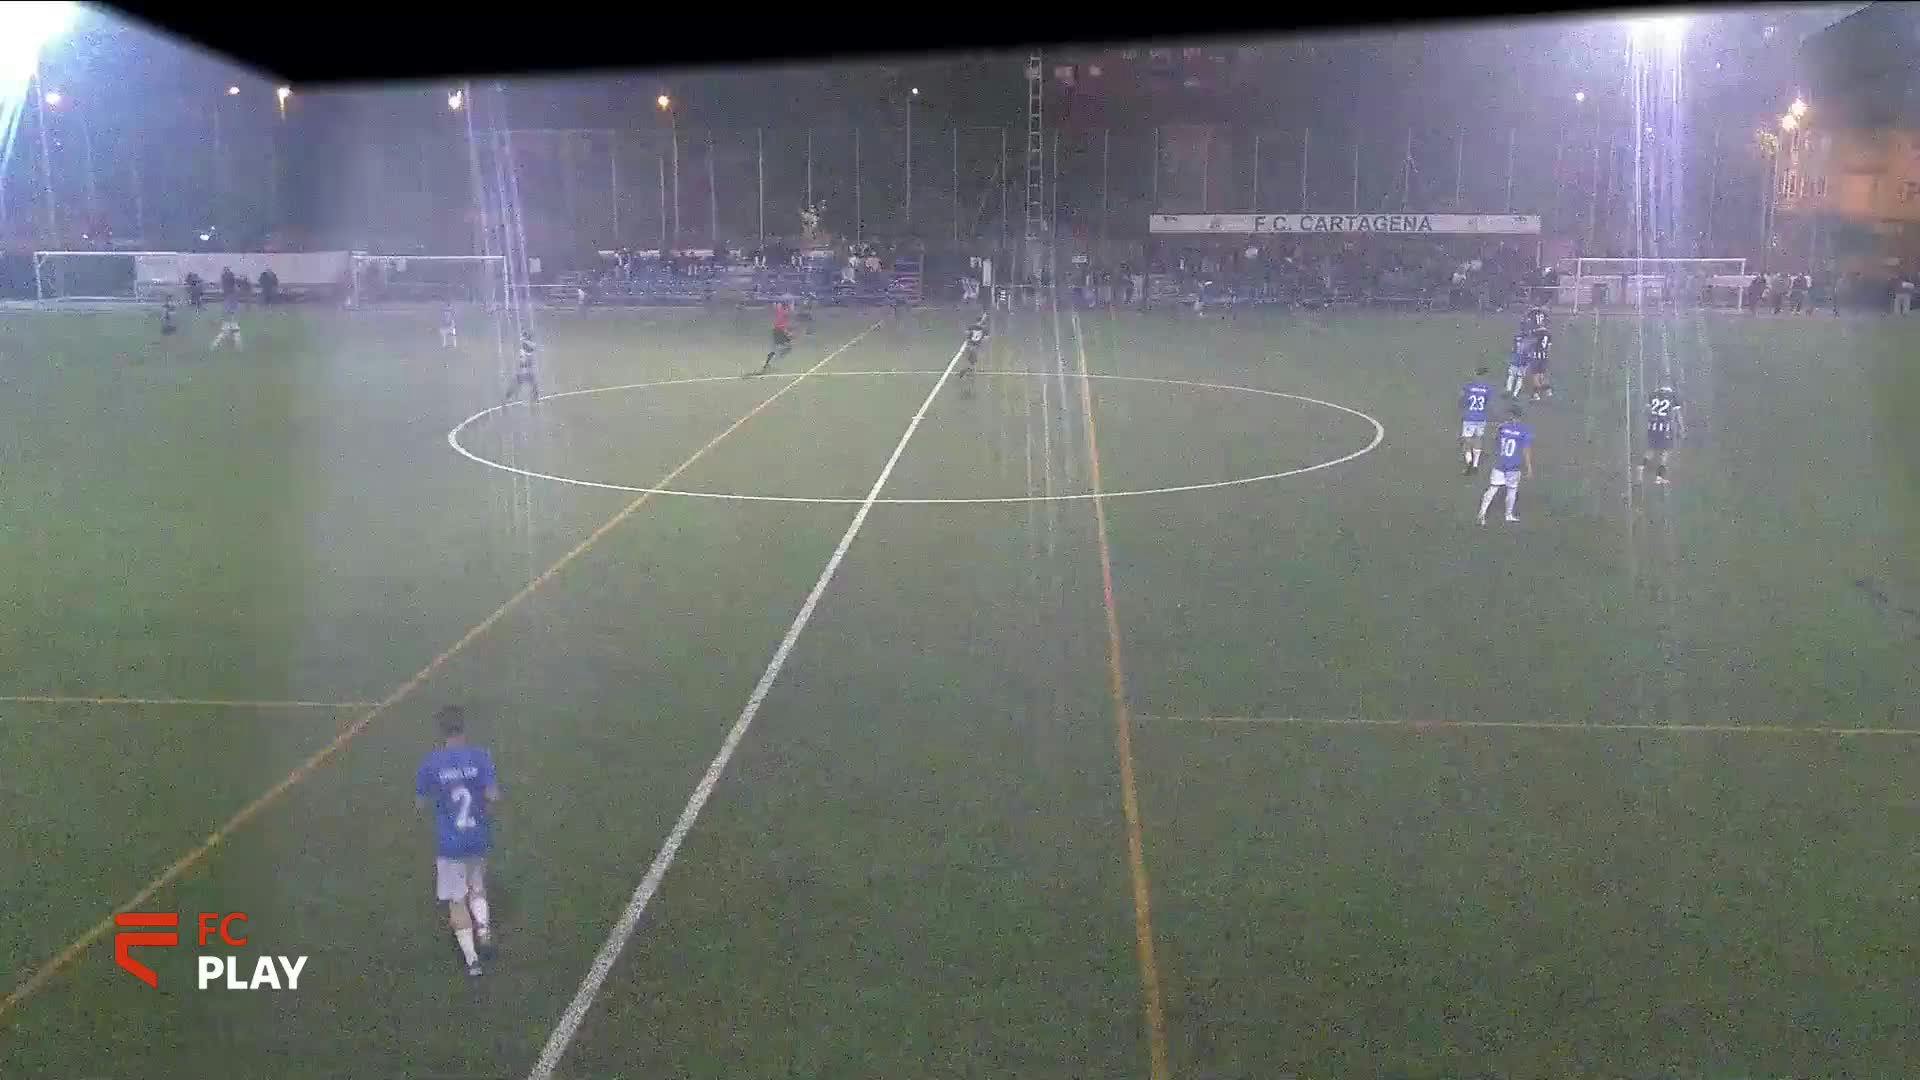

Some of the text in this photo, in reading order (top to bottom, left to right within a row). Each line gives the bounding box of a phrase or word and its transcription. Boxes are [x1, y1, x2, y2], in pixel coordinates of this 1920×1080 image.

[1254, 216, 1431, 231] F.C. CARTAGENA
[1469, 395, 1485, 411] 23
[1651, 398, 1669, 416] 22
[1501, 438, 1516, 456] 10
[452, 788, 476, 828] 2
